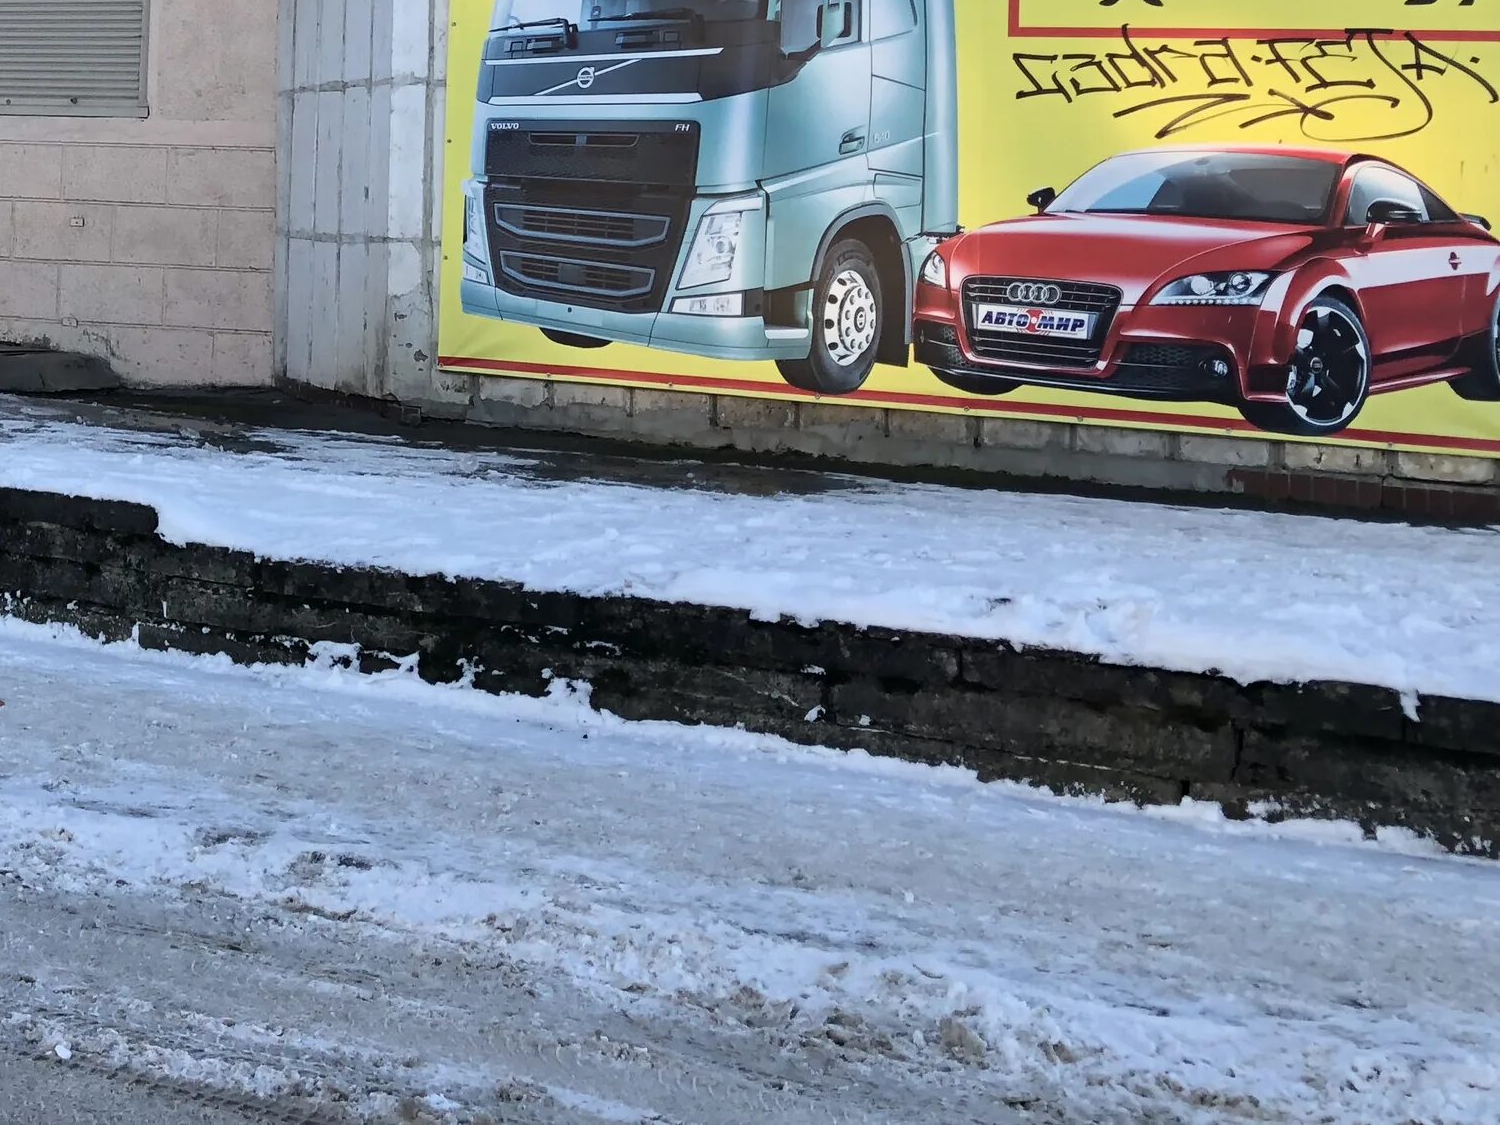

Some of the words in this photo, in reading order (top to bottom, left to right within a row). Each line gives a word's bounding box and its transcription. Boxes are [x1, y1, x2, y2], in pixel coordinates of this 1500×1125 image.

[490, 122, 519, 130] VOLVO
[674, 123, 690, 132] FH
[981, 310, 1029, 328] АВТО
[1037, 315, 1085, 333] МИР
